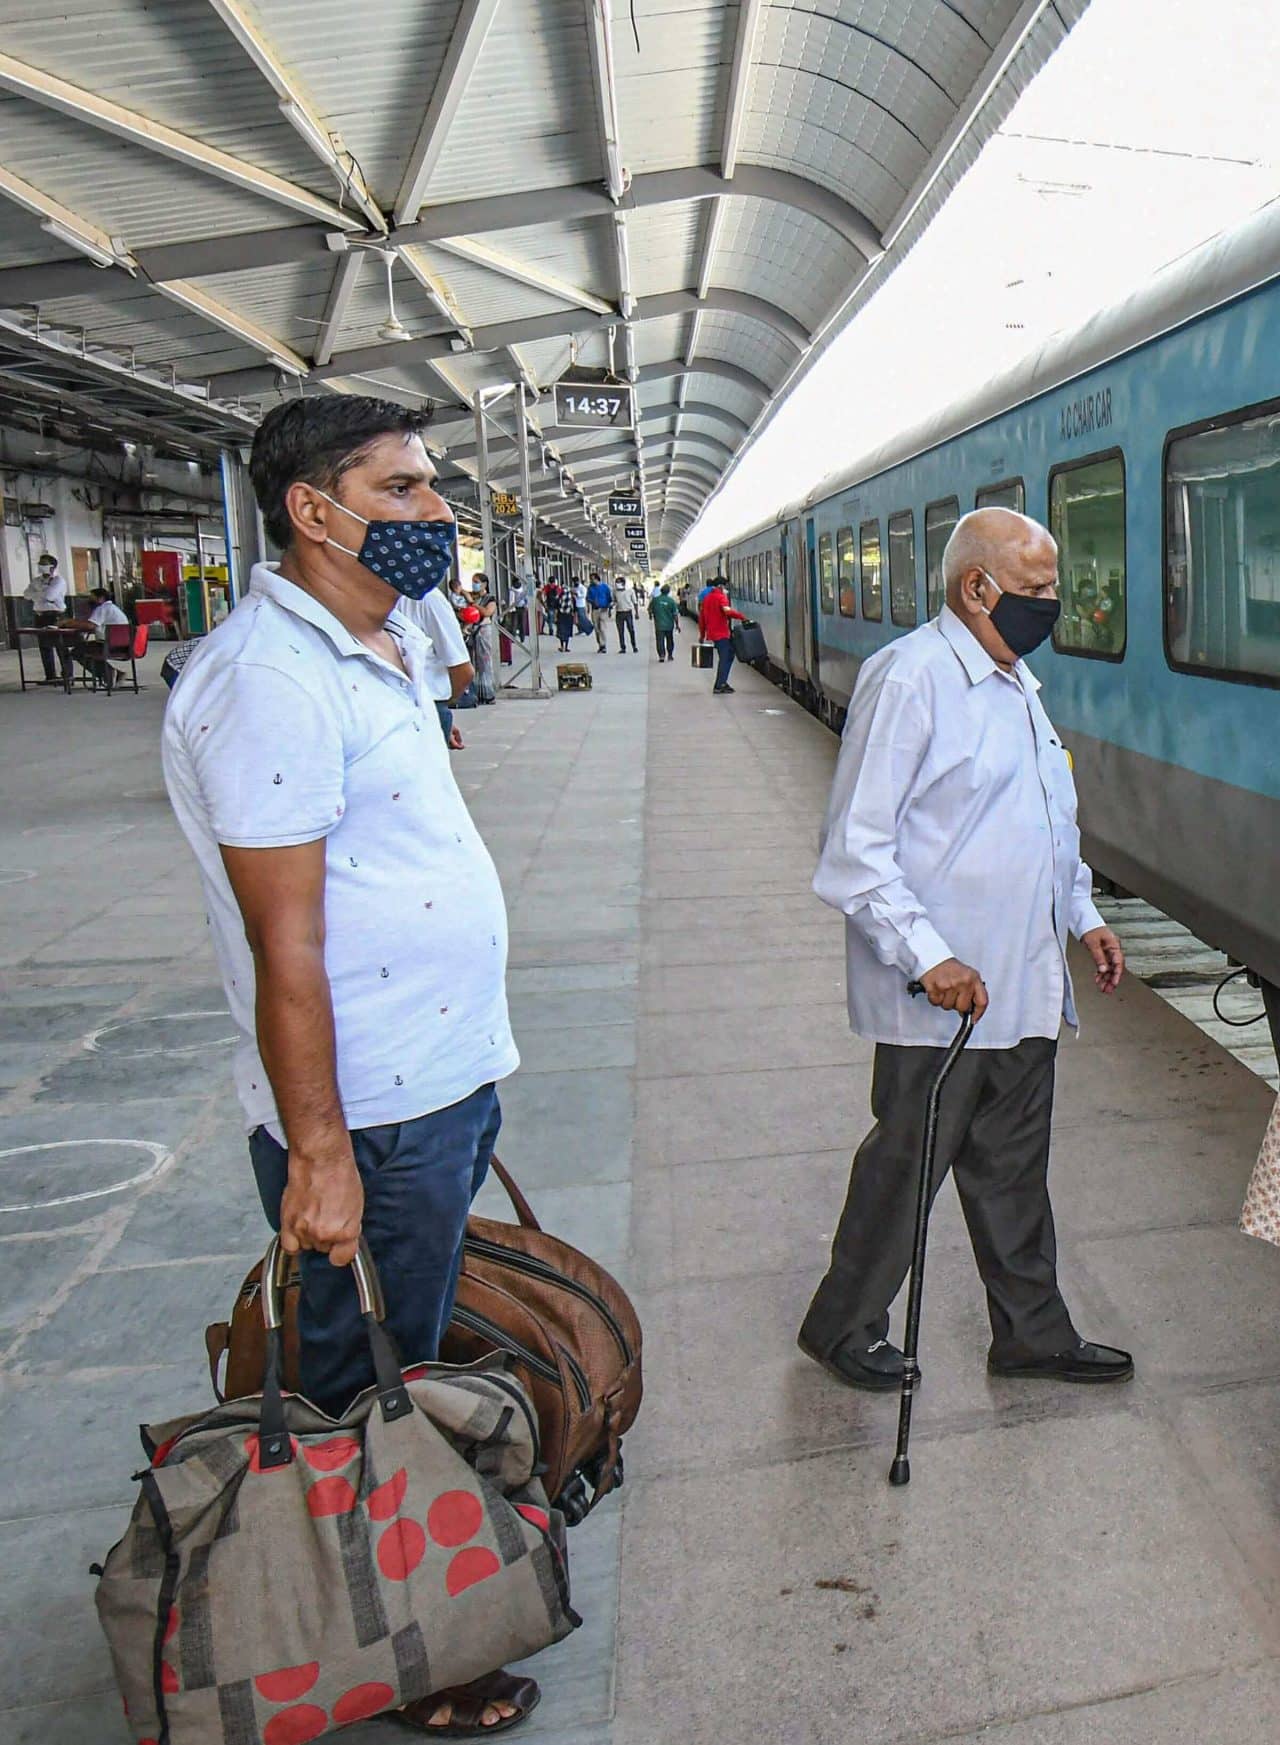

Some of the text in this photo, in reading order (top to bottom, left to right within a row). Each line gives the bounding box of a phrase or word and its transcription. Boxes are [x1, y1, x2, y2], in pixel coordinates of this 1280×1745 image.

[565, 396, 621, 416] 14:37
[1096, 387, 1112, 429] CAR
[612, 503, 637, 512] 14:37
